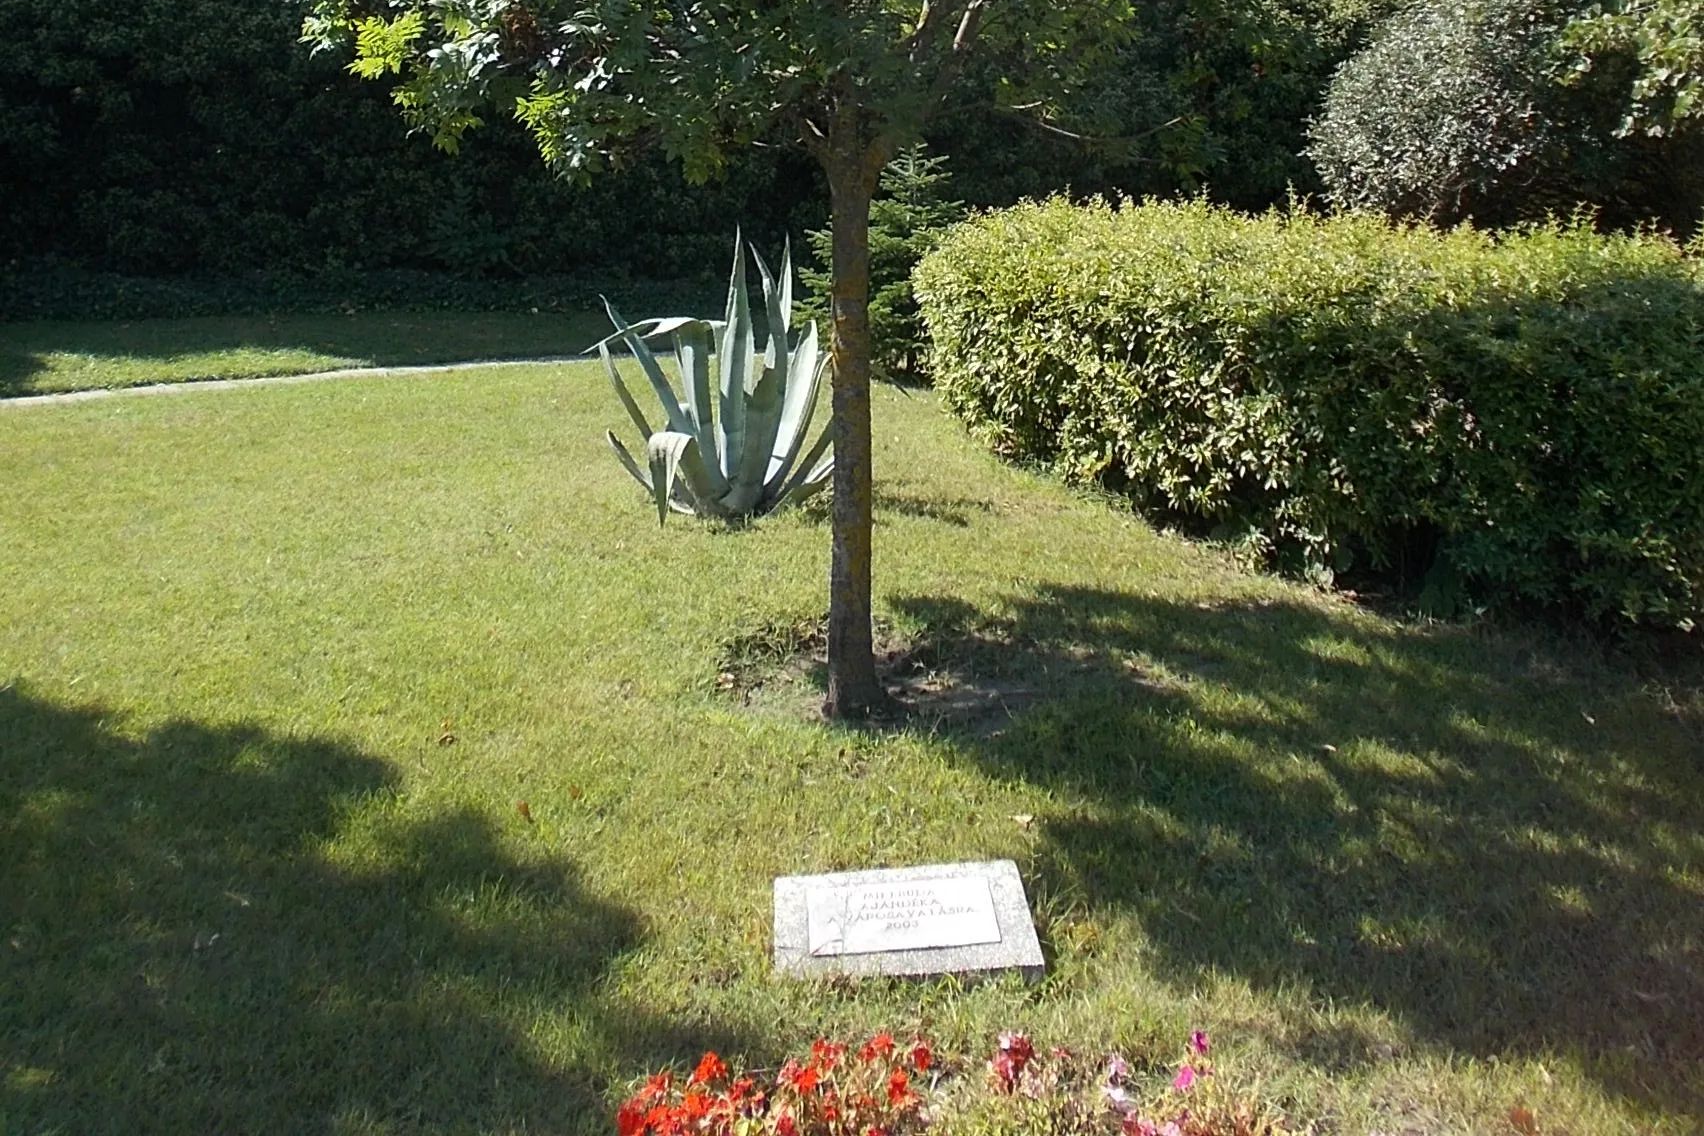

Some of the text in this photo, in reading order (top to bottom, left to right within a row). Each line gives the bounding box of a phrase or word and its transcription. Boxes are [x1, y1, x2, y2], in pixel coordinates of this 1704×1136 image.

[861, 897, 941, 911] AJÁNDÉKA
[826, 916, 838, 924] A
[886, 920, 920, 930] 2003
